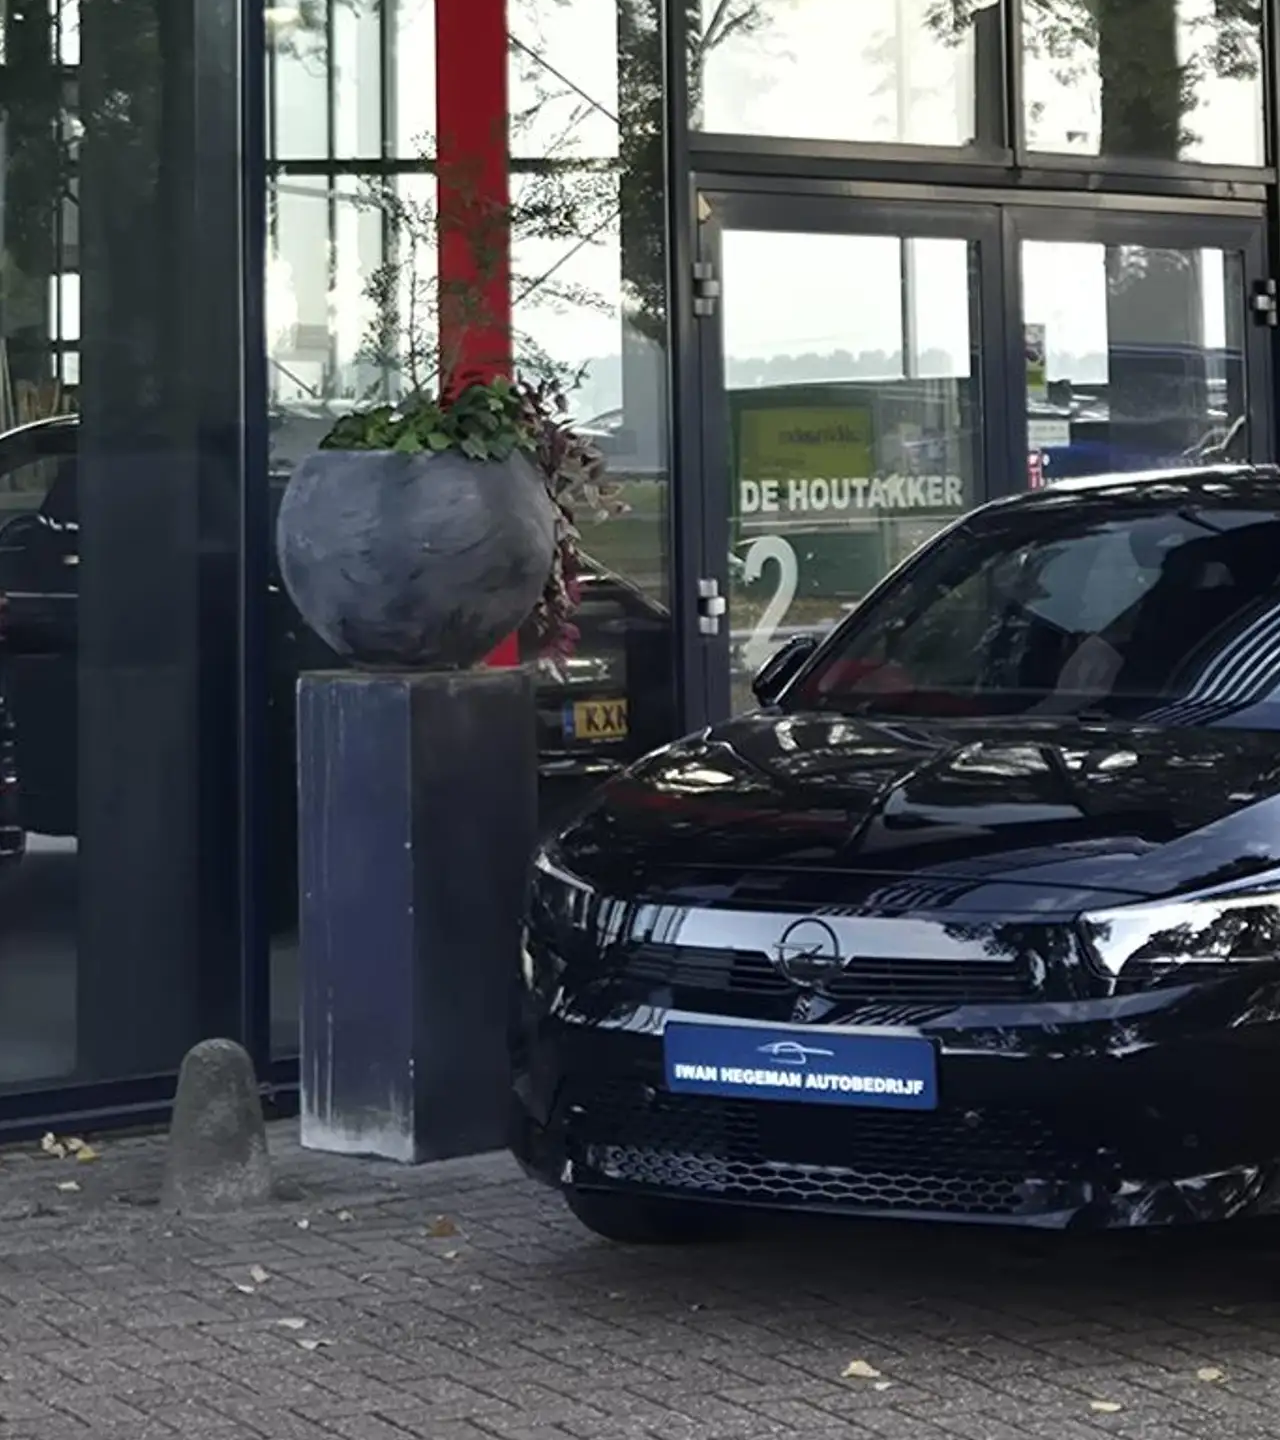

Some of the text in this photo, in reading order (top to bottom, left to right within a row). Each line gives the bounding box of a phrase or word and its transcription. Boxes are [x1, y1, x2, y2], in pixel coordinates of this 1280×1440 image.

[740, 474, 963, 513] DE HOUTAKKER
[743, 535, 798, 671] 2
[674, 1064, 925, 1095] IWAN HEGEMAN AUTOBEDRIJF
